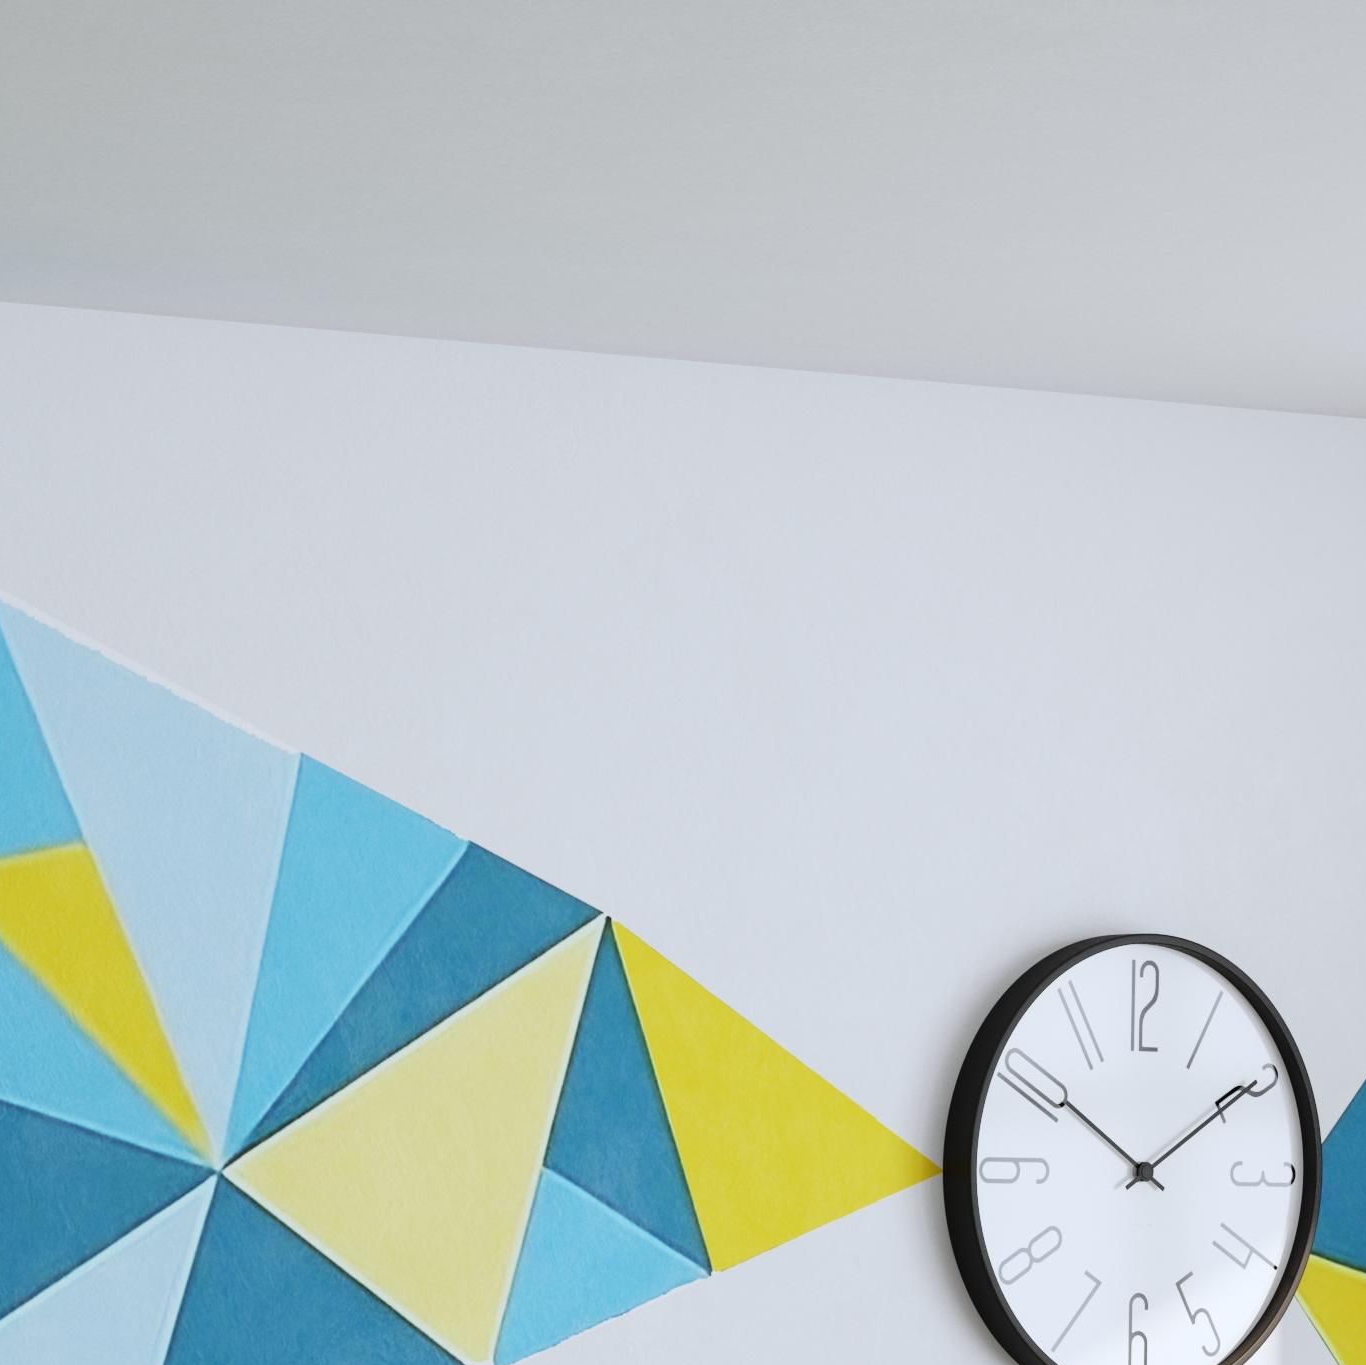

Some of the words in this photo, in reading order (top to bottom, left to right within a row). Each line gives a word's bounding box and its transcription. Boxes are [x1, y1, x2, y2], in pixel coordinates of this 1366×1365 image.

[1130, 959, 1160, 1052] 12
[997, 1047, 1069, 1123] 10
[1215, 1063, 1279, 1124] 2
[979, 1156, 1050, 1184] 9
[1230, 1161, 1296, 1188] 3
[998, 1226, 1063, 1285] 8
[1212, 1222, 1278, 1270] 4
[1051, 1271, 1102, 1352] 7
[1176, 1272, 1221, 1357] 5
